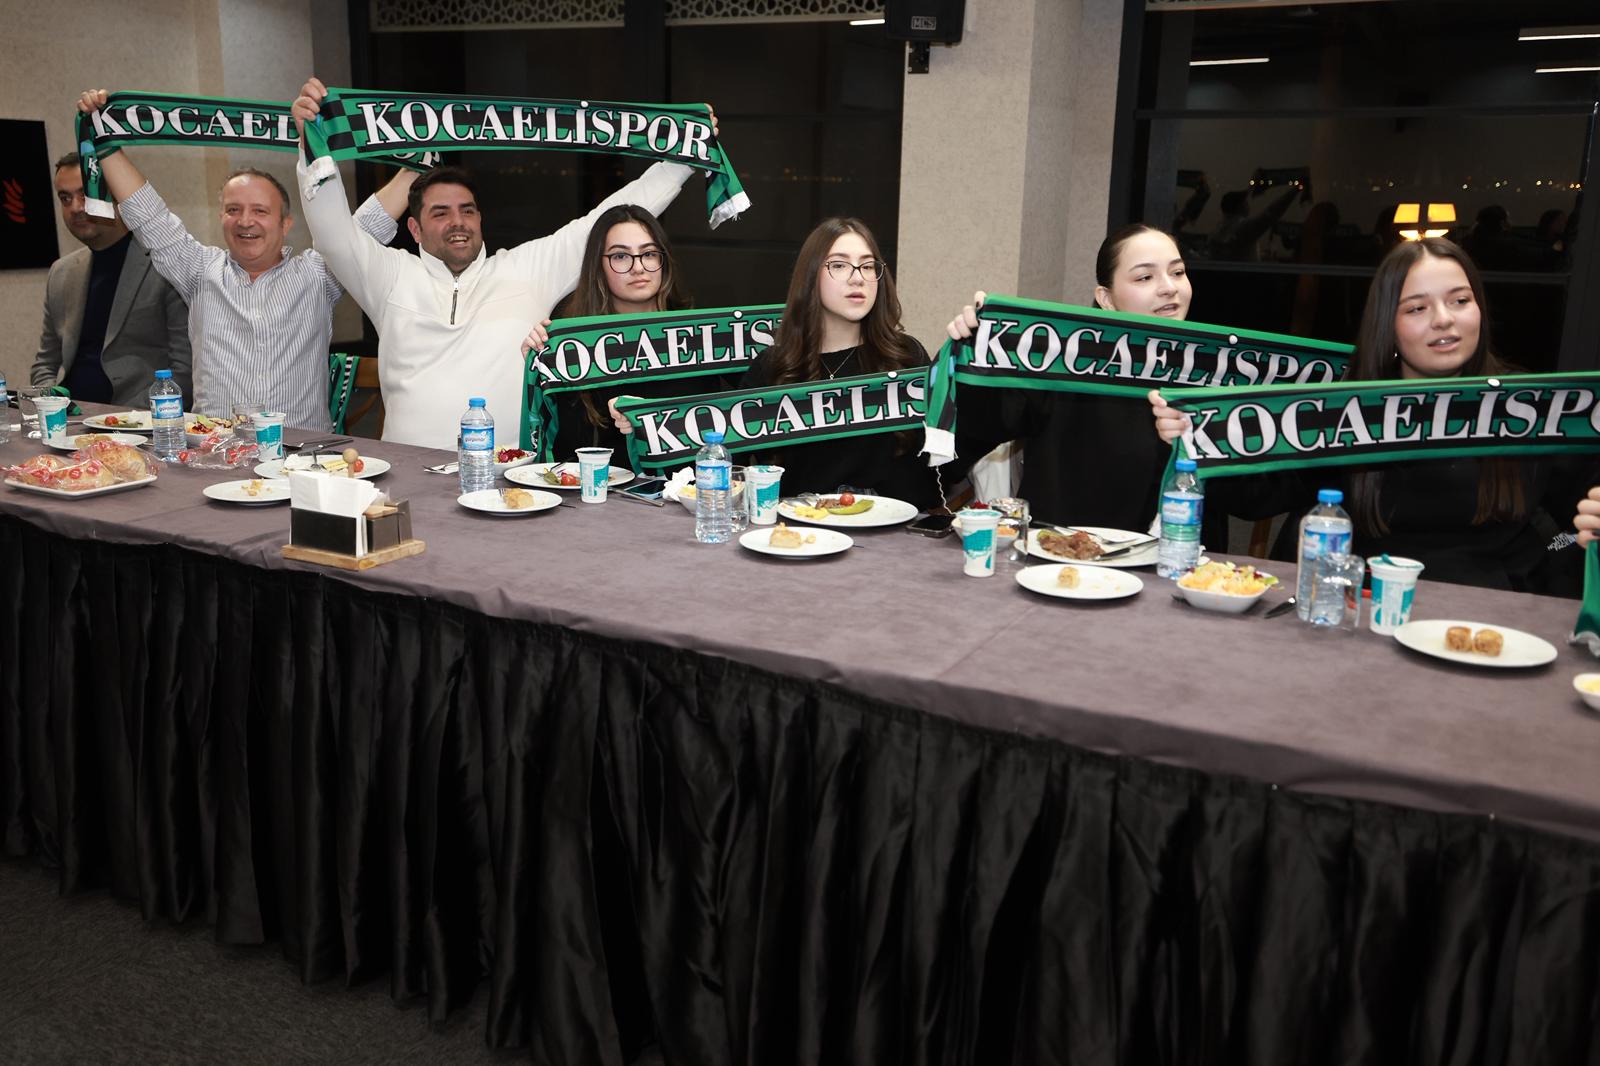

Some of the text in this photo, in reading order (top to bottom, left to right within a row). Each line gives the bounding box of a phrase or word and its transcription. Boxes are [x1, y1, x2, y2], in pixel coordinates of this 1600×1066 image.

[357, 101, 711, 160] KOCAELİSPOR
[531, 311, 783, 385] KOCAELİS
[1181, 378, 1600, 460] KOCAELİSP
